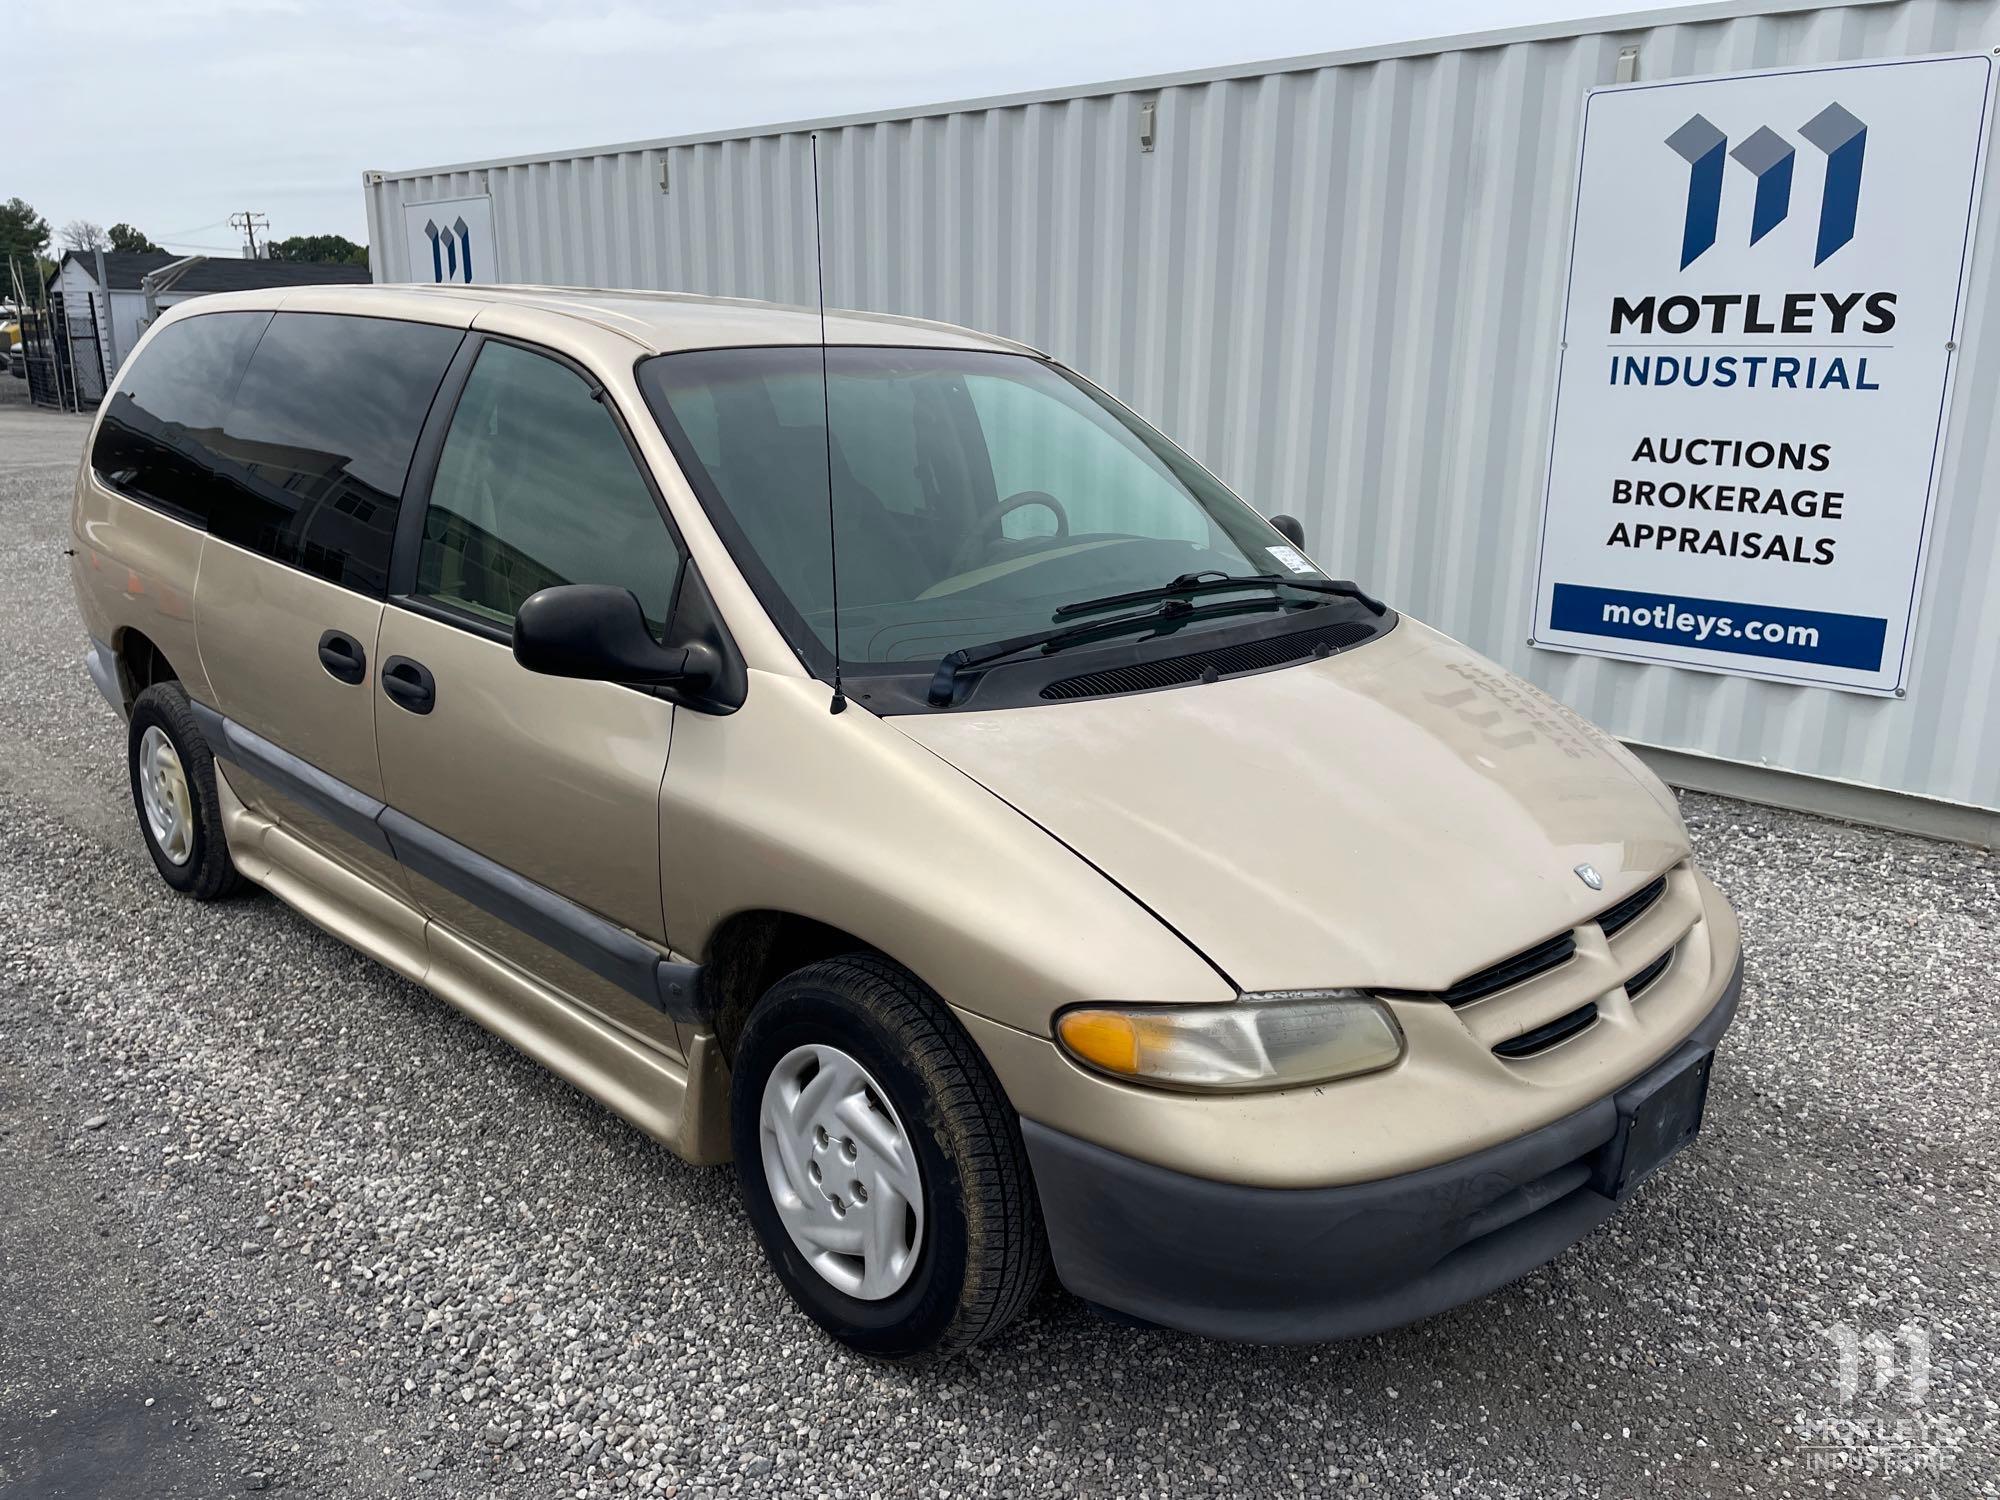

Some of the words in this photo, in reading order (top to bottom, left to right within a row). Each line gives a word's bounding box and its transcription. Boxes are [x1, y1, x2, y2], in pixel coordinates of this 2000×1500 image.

[1609, 291, 1898, 335] MOTLEYS
[1609, 355, 1880, 391] INDUSTRIAL
[1630, 436, 1832, 472] AUCTIONS
[1612, 479, 1845, 520] BROKERAGE
[1605, 522, 1837, 566] APPRAISALS
[1602, 603, 1819, 648] motleys.com
